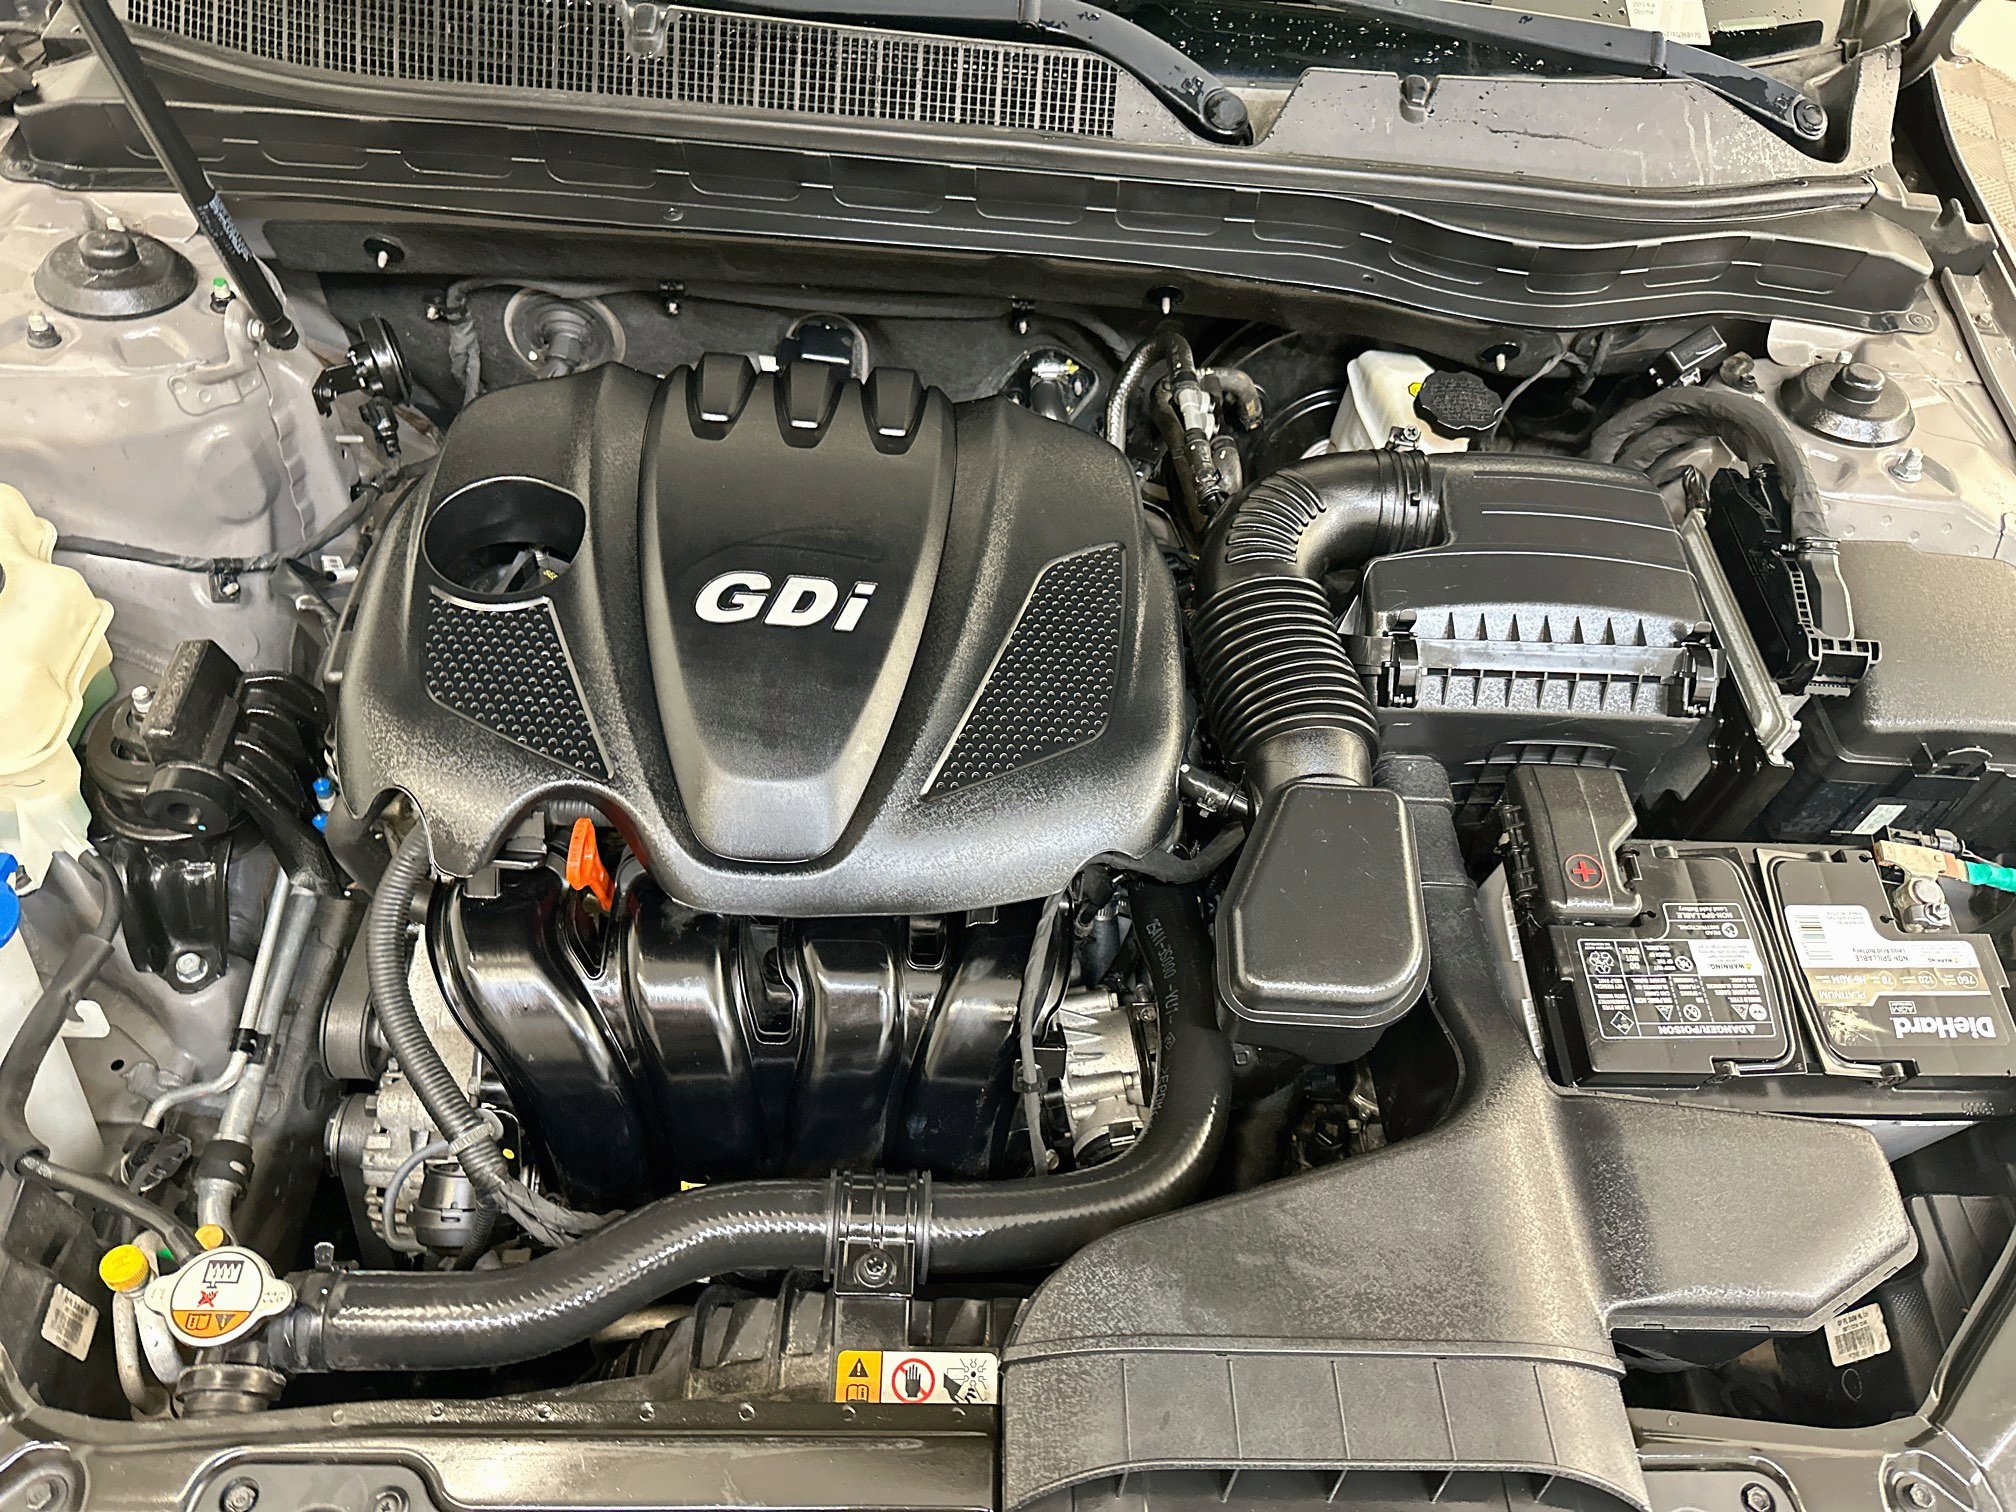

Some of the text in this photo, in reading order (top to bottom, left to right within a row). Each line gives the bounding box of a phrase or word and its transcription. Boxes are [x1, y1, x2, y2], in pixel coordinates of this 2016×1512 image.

[693, 570, 879, 632] GDi
[1818, 990, 1866, 1000] PLATINUM
[1658, 1025, 1746, 1035] DANGER/POISON
